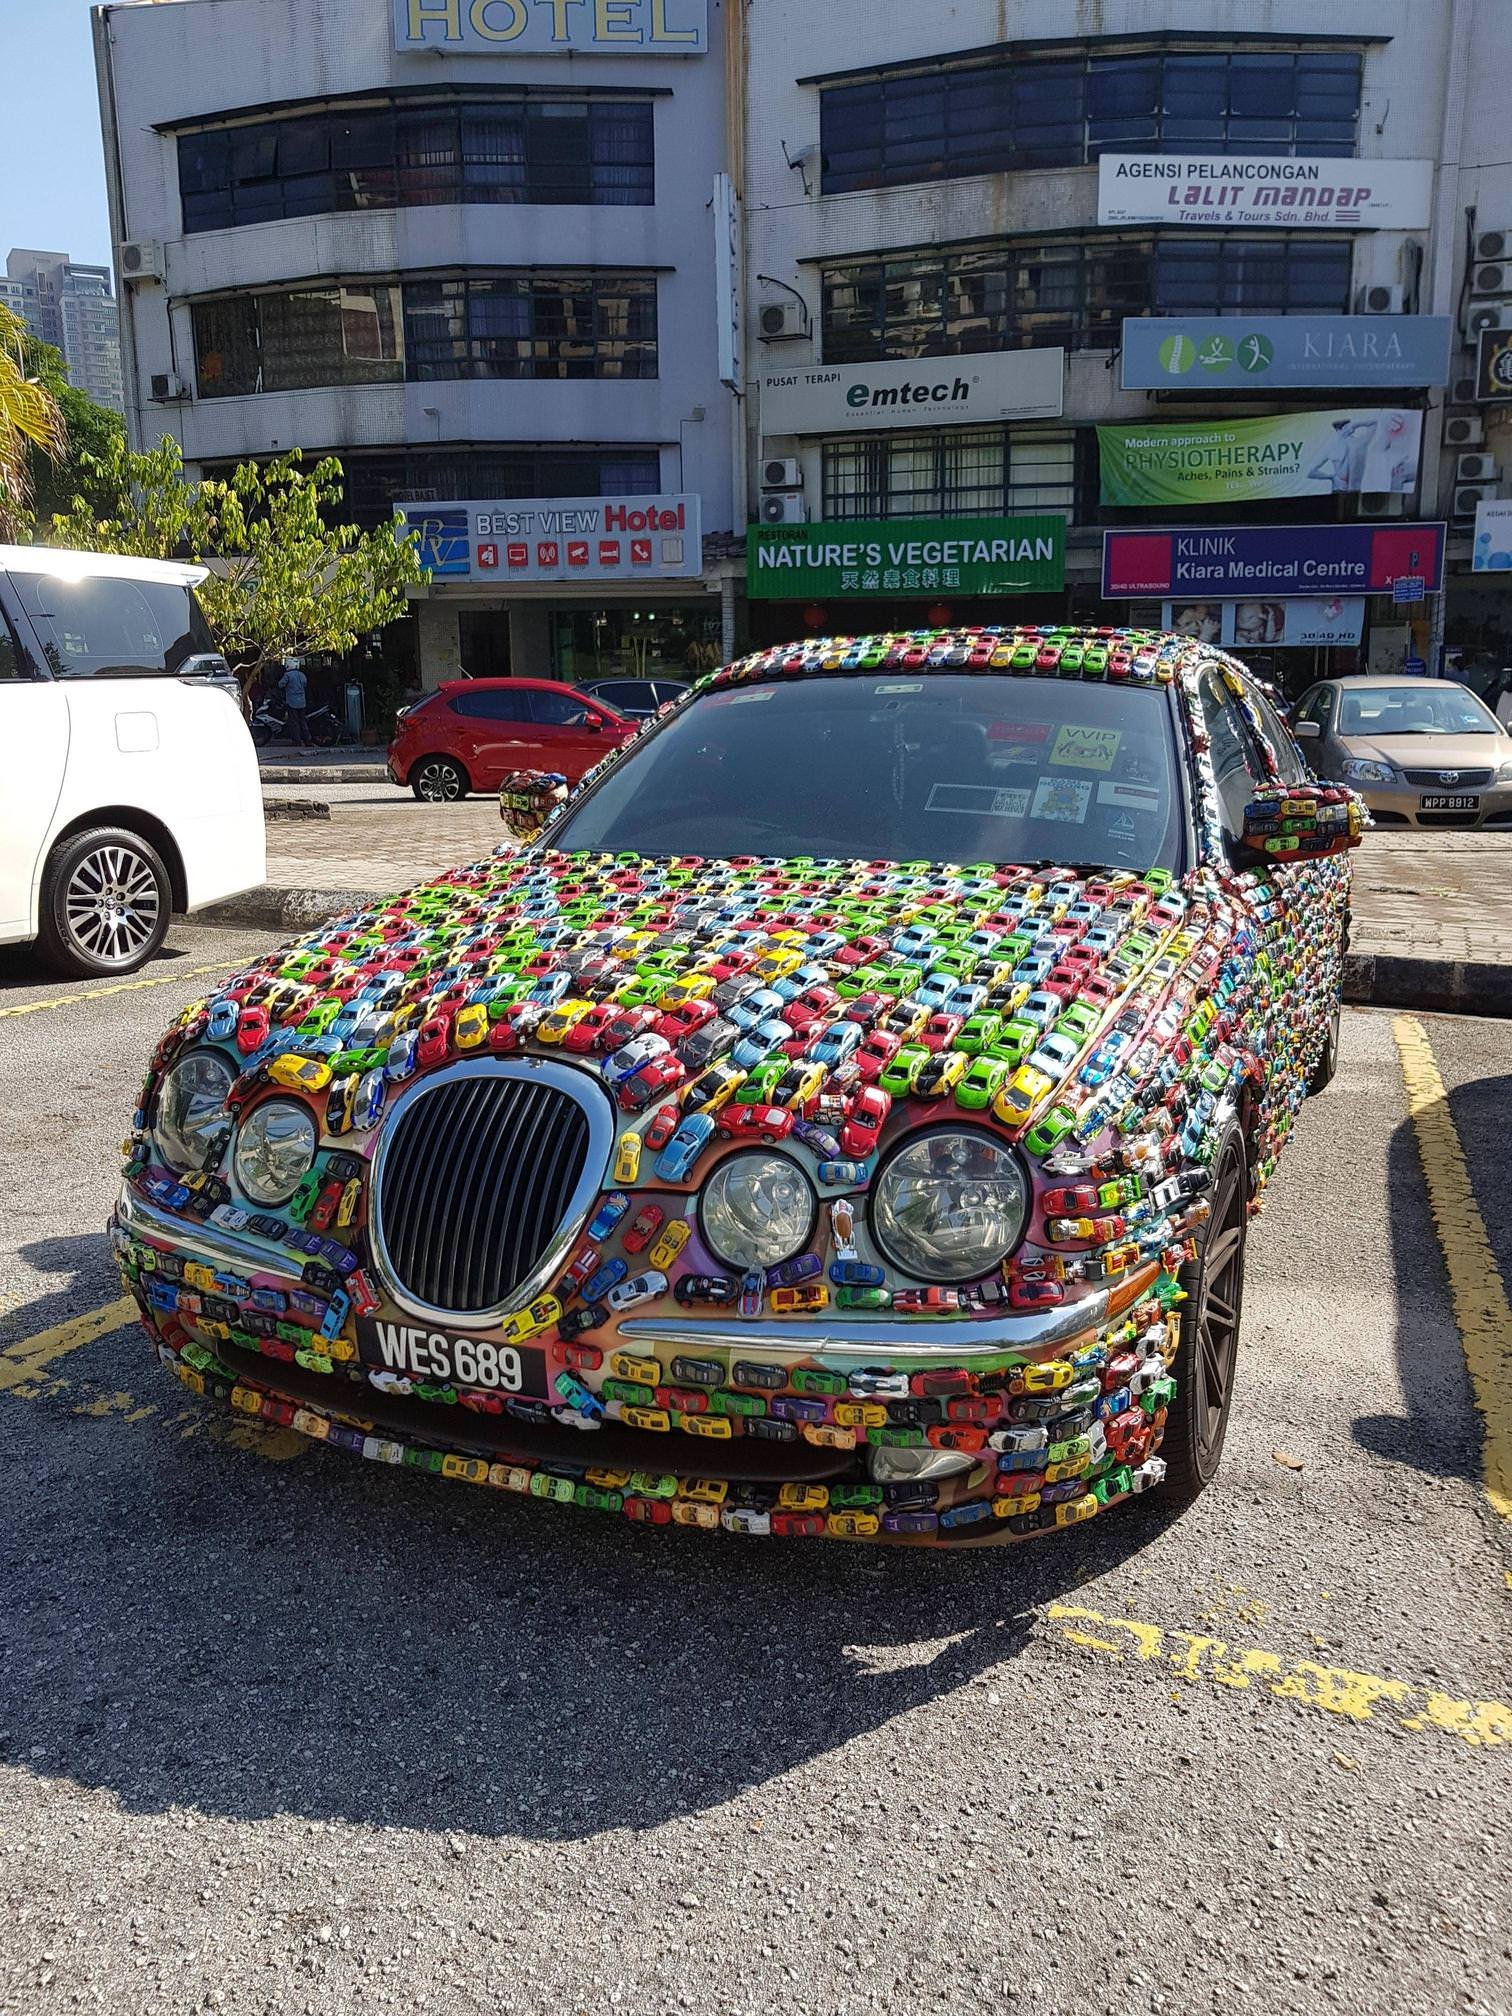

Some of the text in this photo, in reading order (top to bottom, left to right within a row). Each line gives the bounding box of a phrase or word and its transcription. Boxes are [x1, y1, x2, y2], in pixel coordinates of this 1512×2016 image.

[406, 0, 699, 43] HOTEL
[1115, 163, 1319, 180] AGENSI PELANCONGAN
[1179, 210, 1331, 223] Travels & Tours Sdn. Bhd.
[1303, 331, 1403, 358] KIARA
[766, 373, 841, 387] PUSAT TERAPI
[846, 378, 970, 407] emtech
[1125, 433, 1236, 448] Modern approach to
[1125, 441, 1304, 471] PHYSIOTHERAPY
[1177, 462, 1301, 482] Aches, Pains & Strains?
[475, 503, 685, 536] BEST VIEW Hotel
[758, 528, 809, 541] RESTORAN
[758, 537, 1053, 569] NATURE'S VEGETARIAN
[1177, 537, 1236, 557] KLINIK
[841, 568, 961, 590] 天然素食料理
[1176, 559, 1366, 579] Kiara Medical Centre
[1065, 728, 1117, 742] VVIP
[1425, 797, 1475, 808] WPP 8912
[376, 1321, 523, 1392] WES 689
